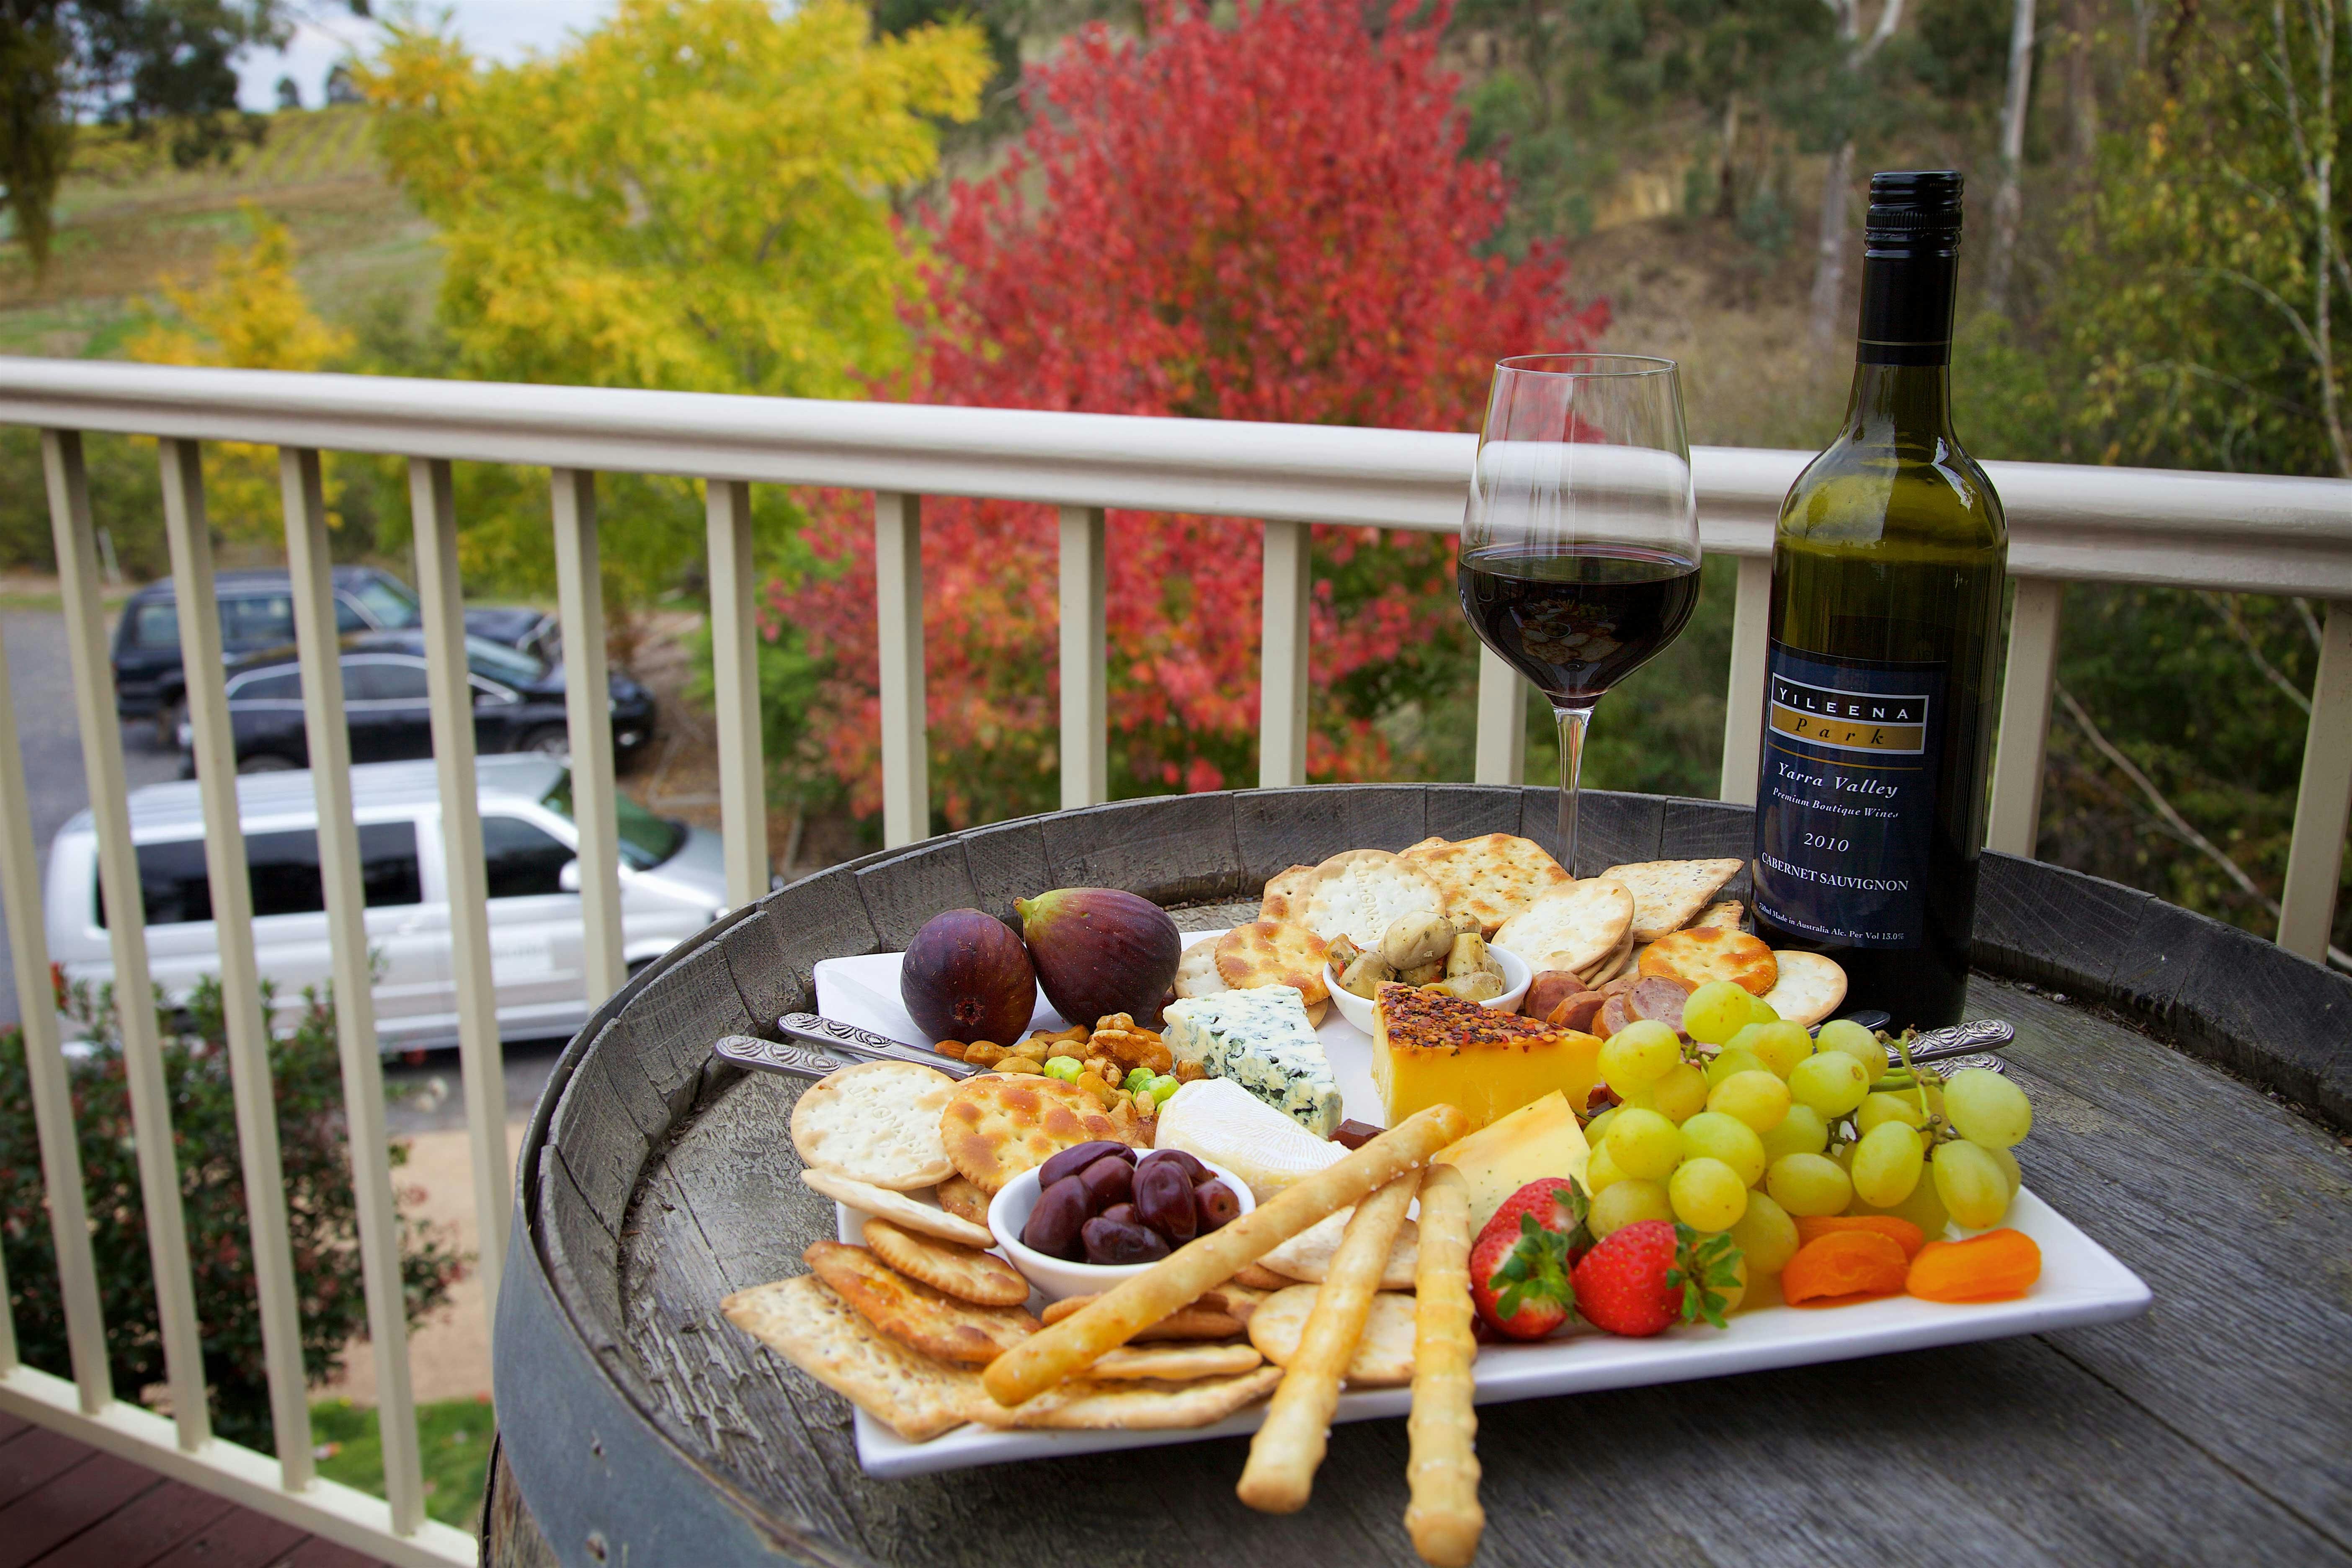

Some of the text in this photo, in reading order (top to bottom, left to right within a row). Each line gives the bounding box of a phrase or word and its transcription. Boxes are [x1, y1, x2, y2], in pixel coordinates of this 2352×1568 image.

[1779, 687, 1908, 719] YILEENA
[1795, 717, 1884, 745] Park
[1779, 761, 1898, 799] Yarra Valley
[1772, 787, 1899, 818] Premium Boutique Wines
[1803, 833, 1849, 852] 2010
[1761, 852, 1909, 891] CABERNET SAUVIGNON
[1759, 902, 1772, 915] 750ml
[1772, 910, 1788, 922] Made
[1789, 917, 1795, 925] in
[1796, 920, 1829, 934] Australia
[1831, 928, 1847, 936] Alc.
[1849, 930, 1864, 939] Per
